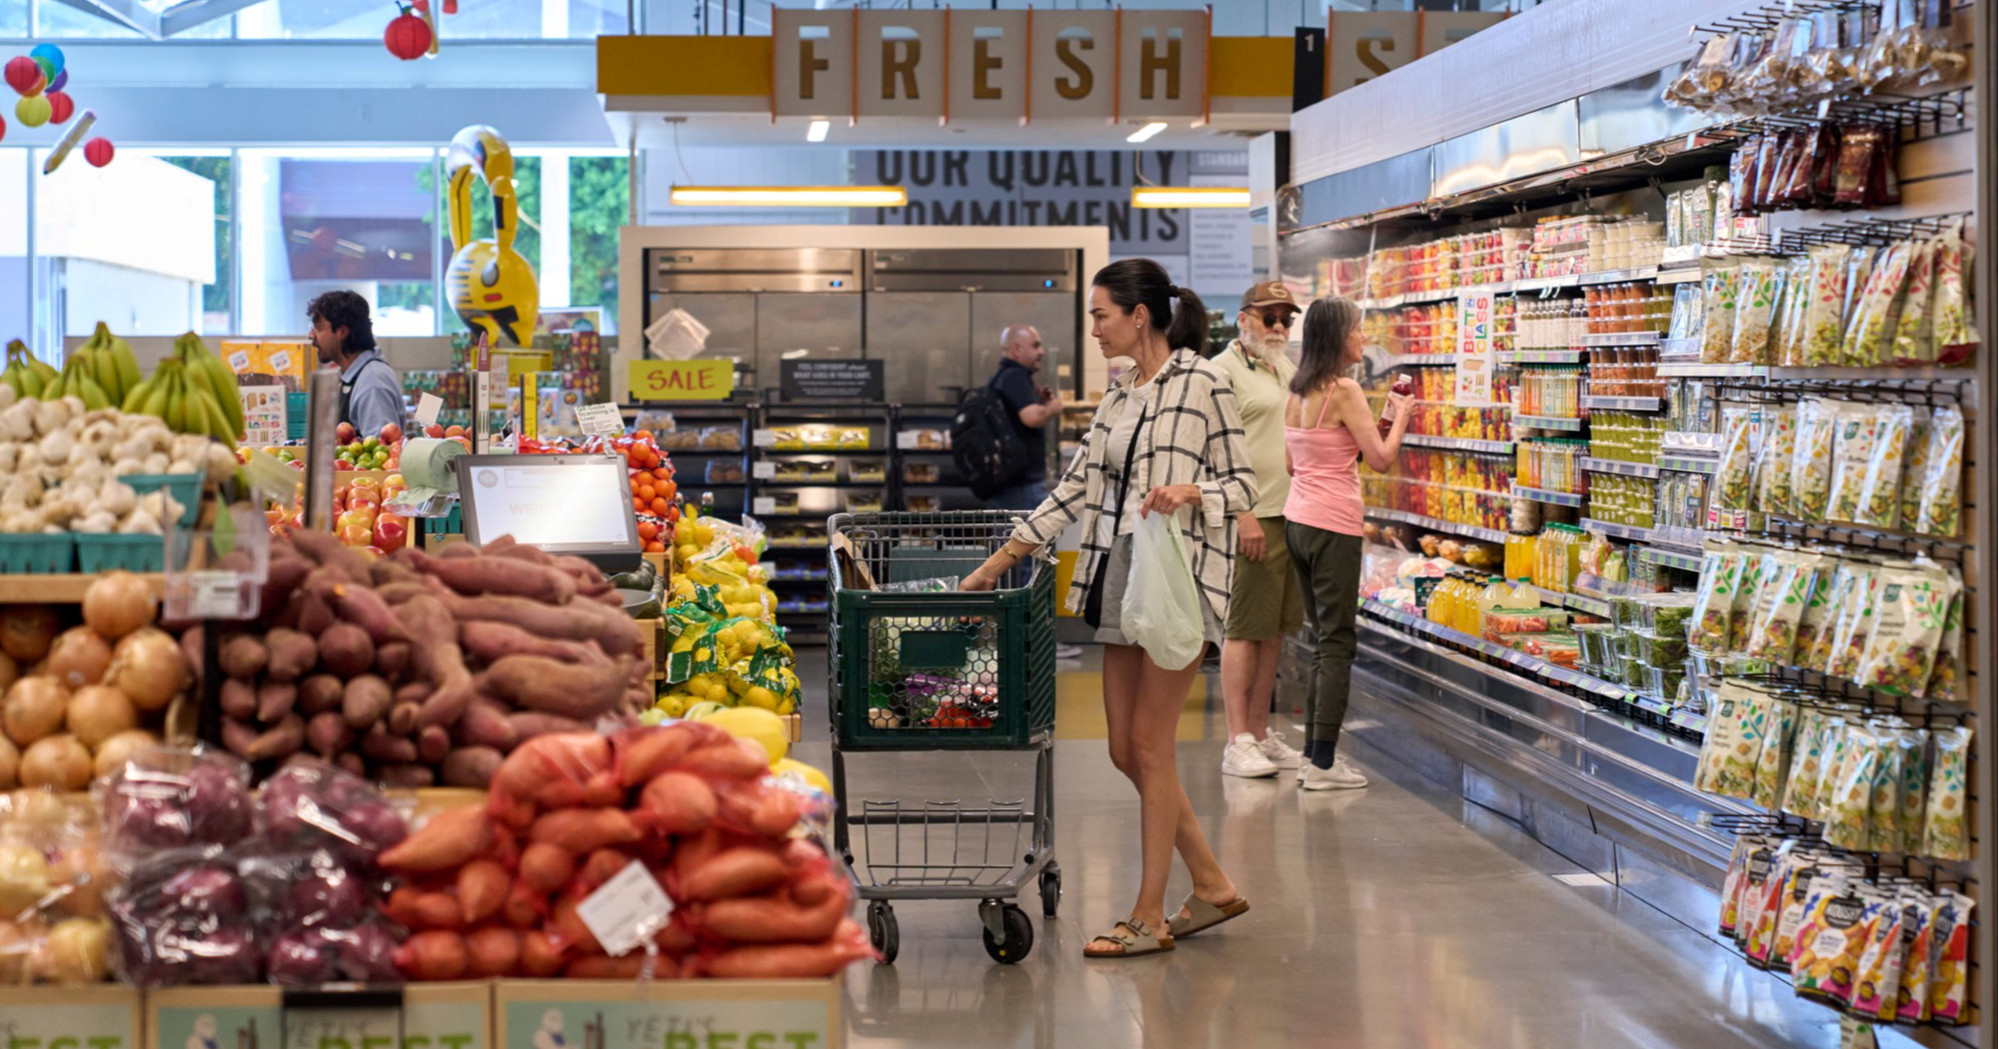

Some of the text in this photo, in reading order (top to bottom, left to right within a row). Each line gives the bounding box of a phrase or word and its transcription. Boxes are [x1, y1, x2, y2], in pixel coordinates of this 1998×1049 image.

[799, 26, 1181, 99] FRESH
[1305, 33, 1314, 52] 1
[876, 150, 1176, 192] OUR QUALITY
[1475, 297, 1488, 354] CLASS
[647, 367, 716, 391] SALE
